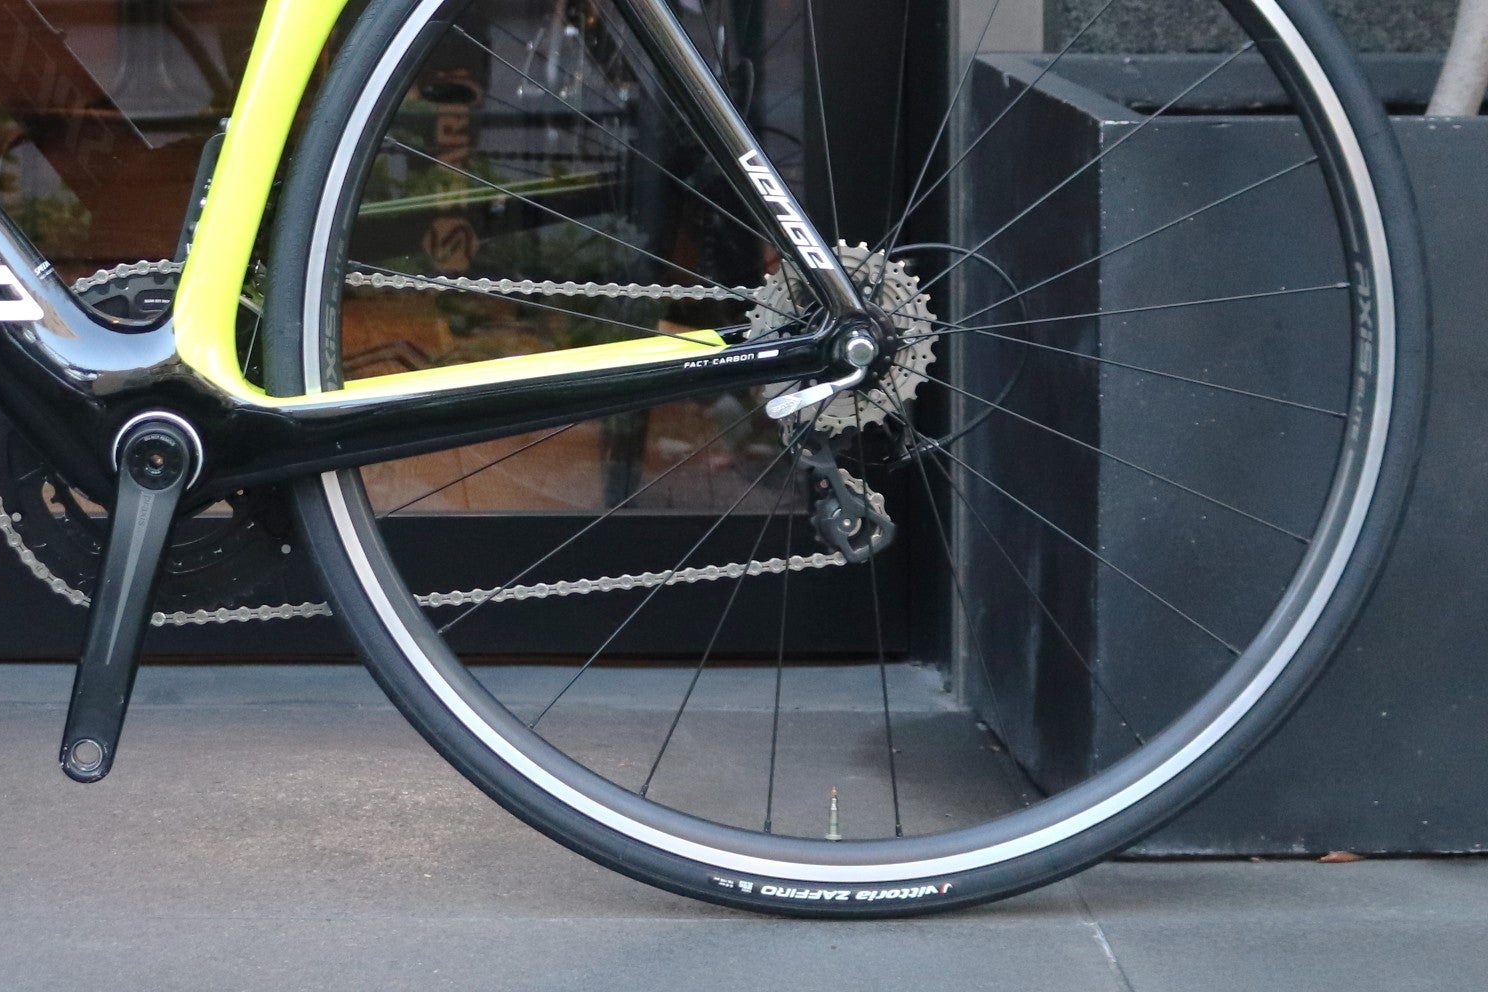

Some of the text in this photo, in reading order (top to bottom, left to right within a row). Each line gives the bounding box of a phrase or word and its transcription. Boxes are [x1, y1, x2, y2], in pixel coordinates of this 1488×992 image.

[684, 353, 755, 369] FACT CARBON
[760, 885, 851, 901] ZAFFIRO
[855, 885, 939, 901] vittoria
